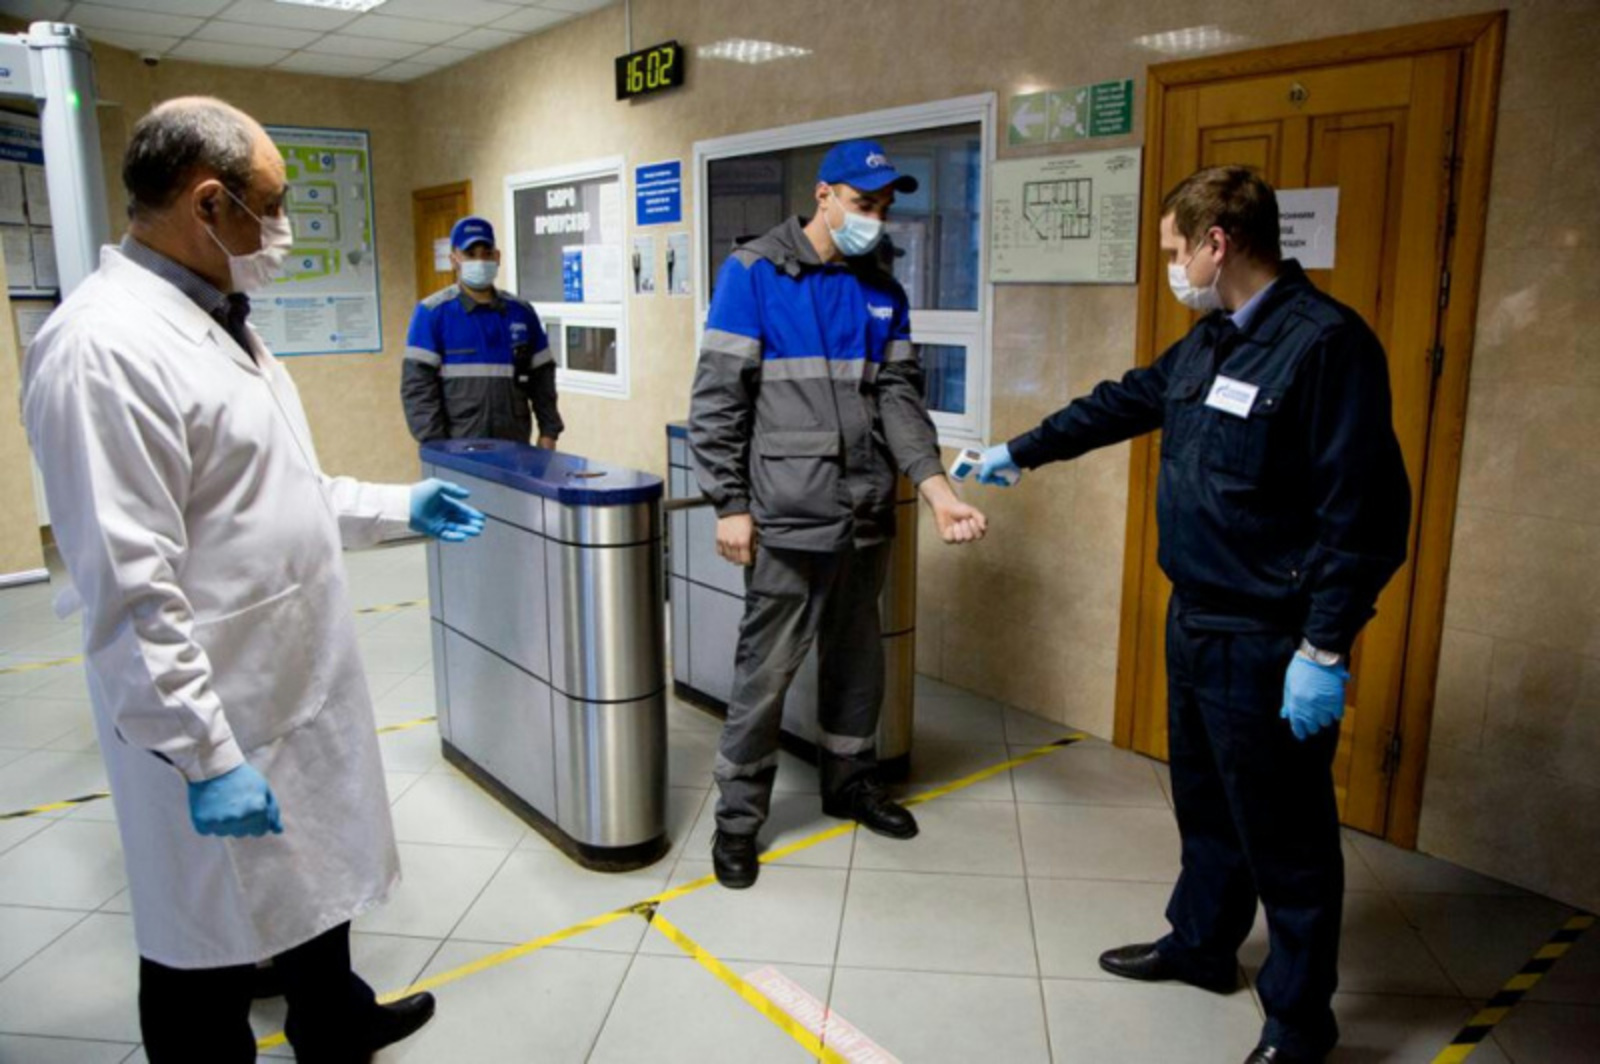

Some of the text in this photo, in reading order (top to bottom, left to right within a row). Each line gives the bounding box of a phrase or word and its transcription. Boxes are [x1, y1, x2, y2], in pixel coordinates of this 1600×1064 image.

[546, 186, 576, 209] БЮРО
[534, 211, 591, 235] ПРОПУСКОВ
[1279, 210, 1315, 220] РОННИМ
